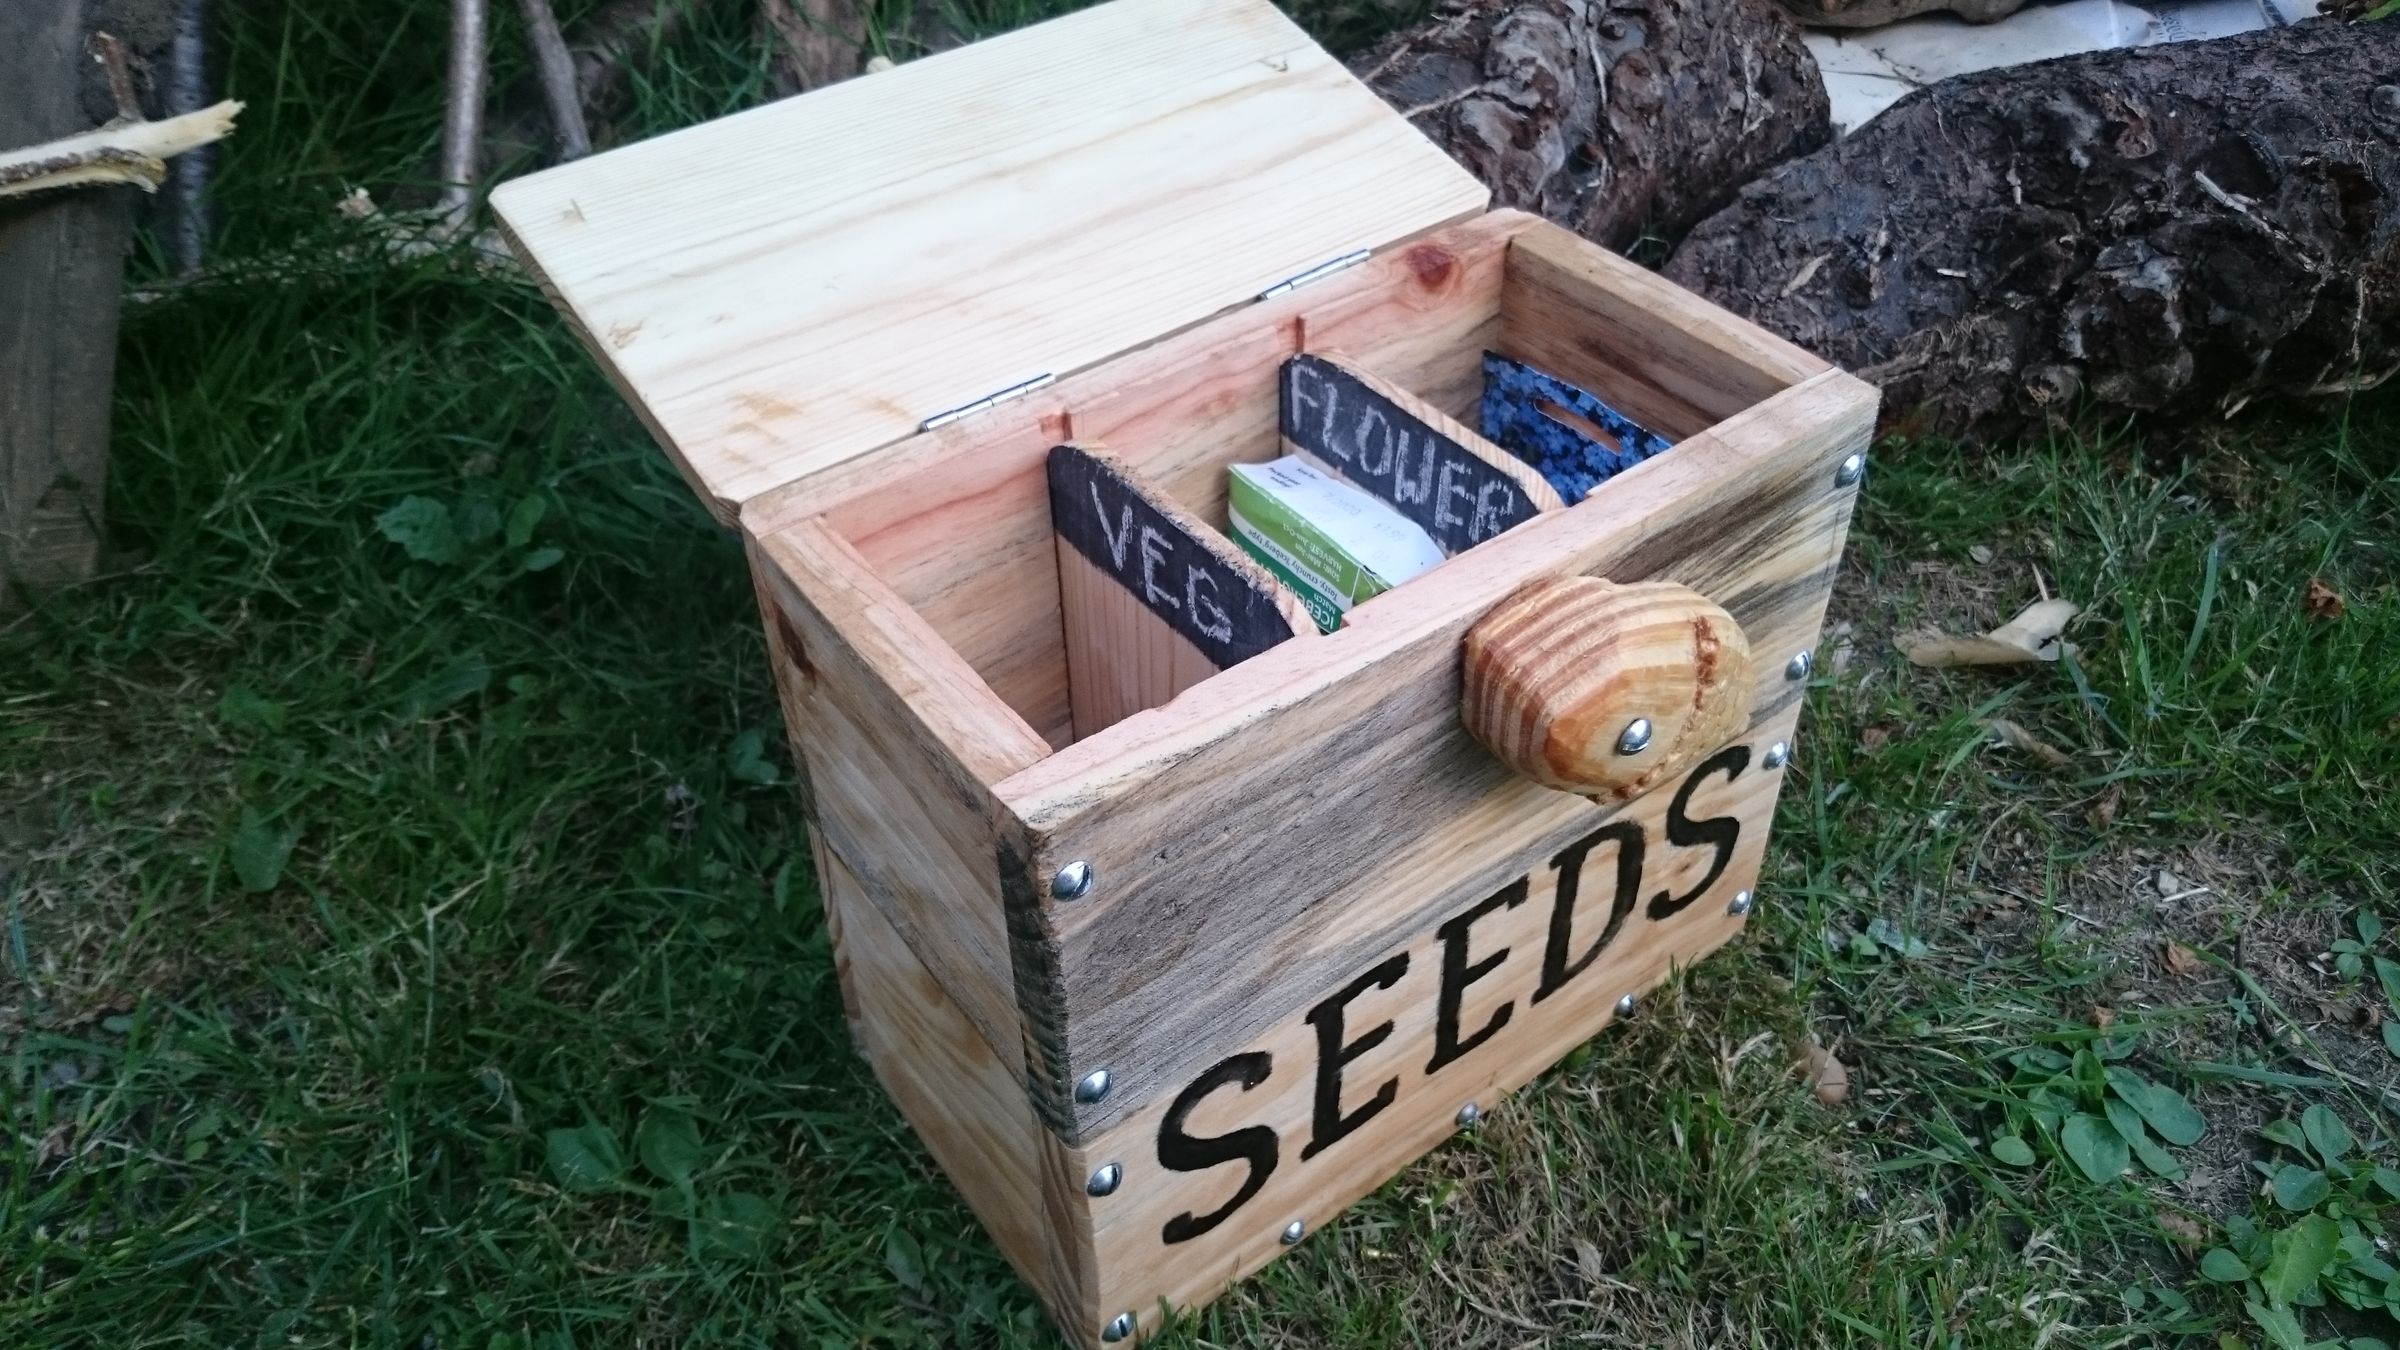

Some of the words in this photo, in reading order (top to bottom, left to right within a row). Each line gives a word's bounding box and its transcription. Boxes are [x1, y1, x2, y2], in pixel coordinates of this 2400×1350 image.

[1290, 363, 1514, 544] FLOWER
[1089, 480, 1233, 645] VEG
[1247, 529, 1263, 544] type
[1292, 560, 1318, 584] crunchy
[1310, 543, 1342, 572] HARVEST:
[1157, 744, 1751, 1245] SEEDS
